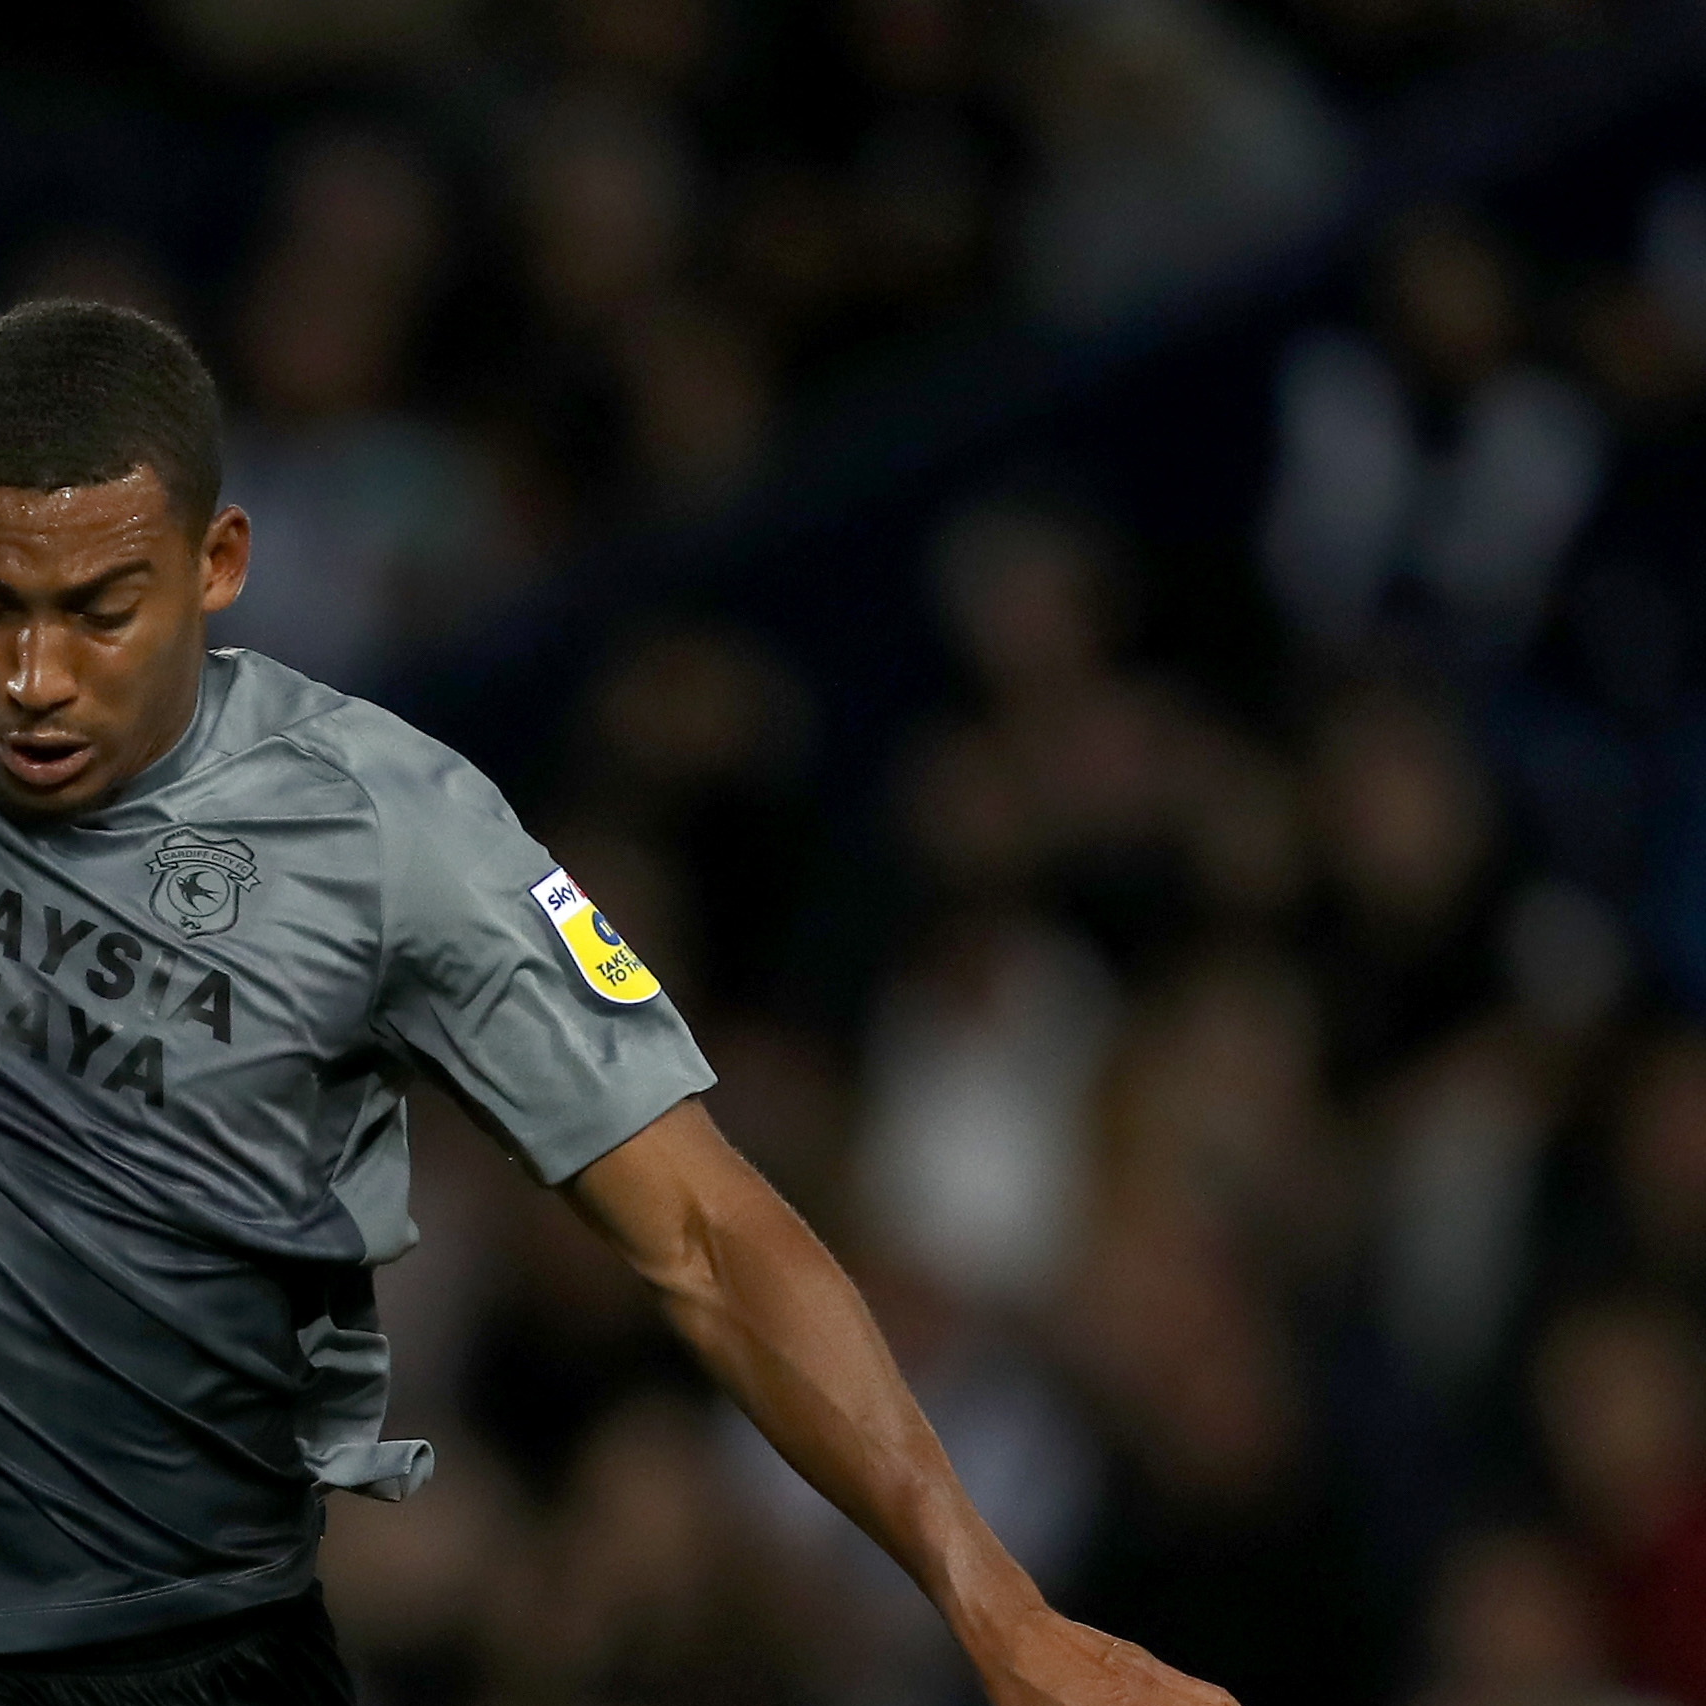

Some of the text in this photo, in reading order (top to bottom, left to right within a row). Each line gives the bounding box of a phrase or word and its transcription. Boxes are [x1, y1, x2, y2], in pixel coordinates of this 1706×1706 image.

[162, 849, 249, 874] CARDIFF CITY FC
[547, 882, 577, 911] sky
[596, 949, 629, 977] TAKE
[607, 968, 627, 987] TO
